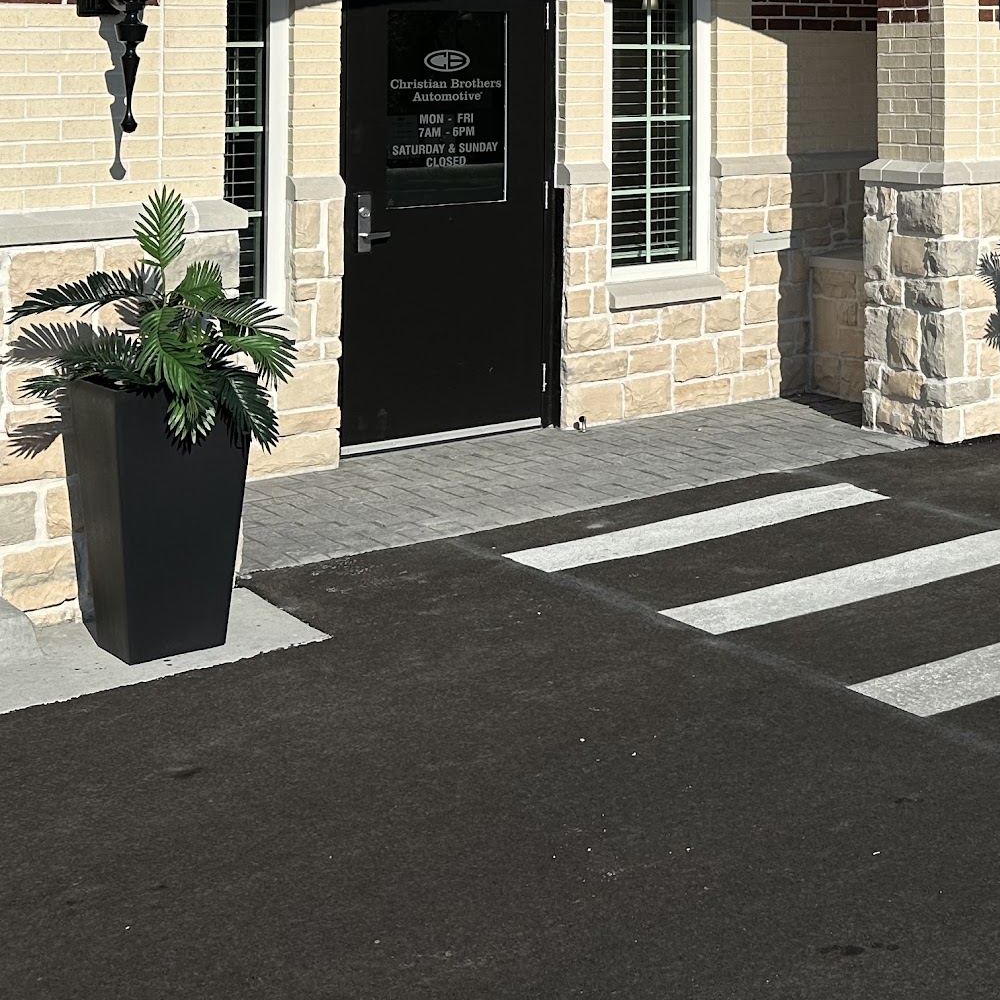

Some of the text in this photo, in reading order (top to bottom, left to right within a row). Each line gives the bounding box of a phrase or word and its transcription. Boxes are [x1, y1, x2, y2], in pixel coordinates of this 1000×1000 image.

[390, 78, 502, 89] Christian Brothers
[412, 91, 483, 102] Automotive
[419, 113, 444, 125] MON
[457, 112, 474, 124] FRI
[418, 126, 442, 138] 7AM
[452, 125, 476, 138] 6PM
[392, 141, 498, 156] SATURDAY & SUNDAY
[426, 155, 467, 168] CLOSED
